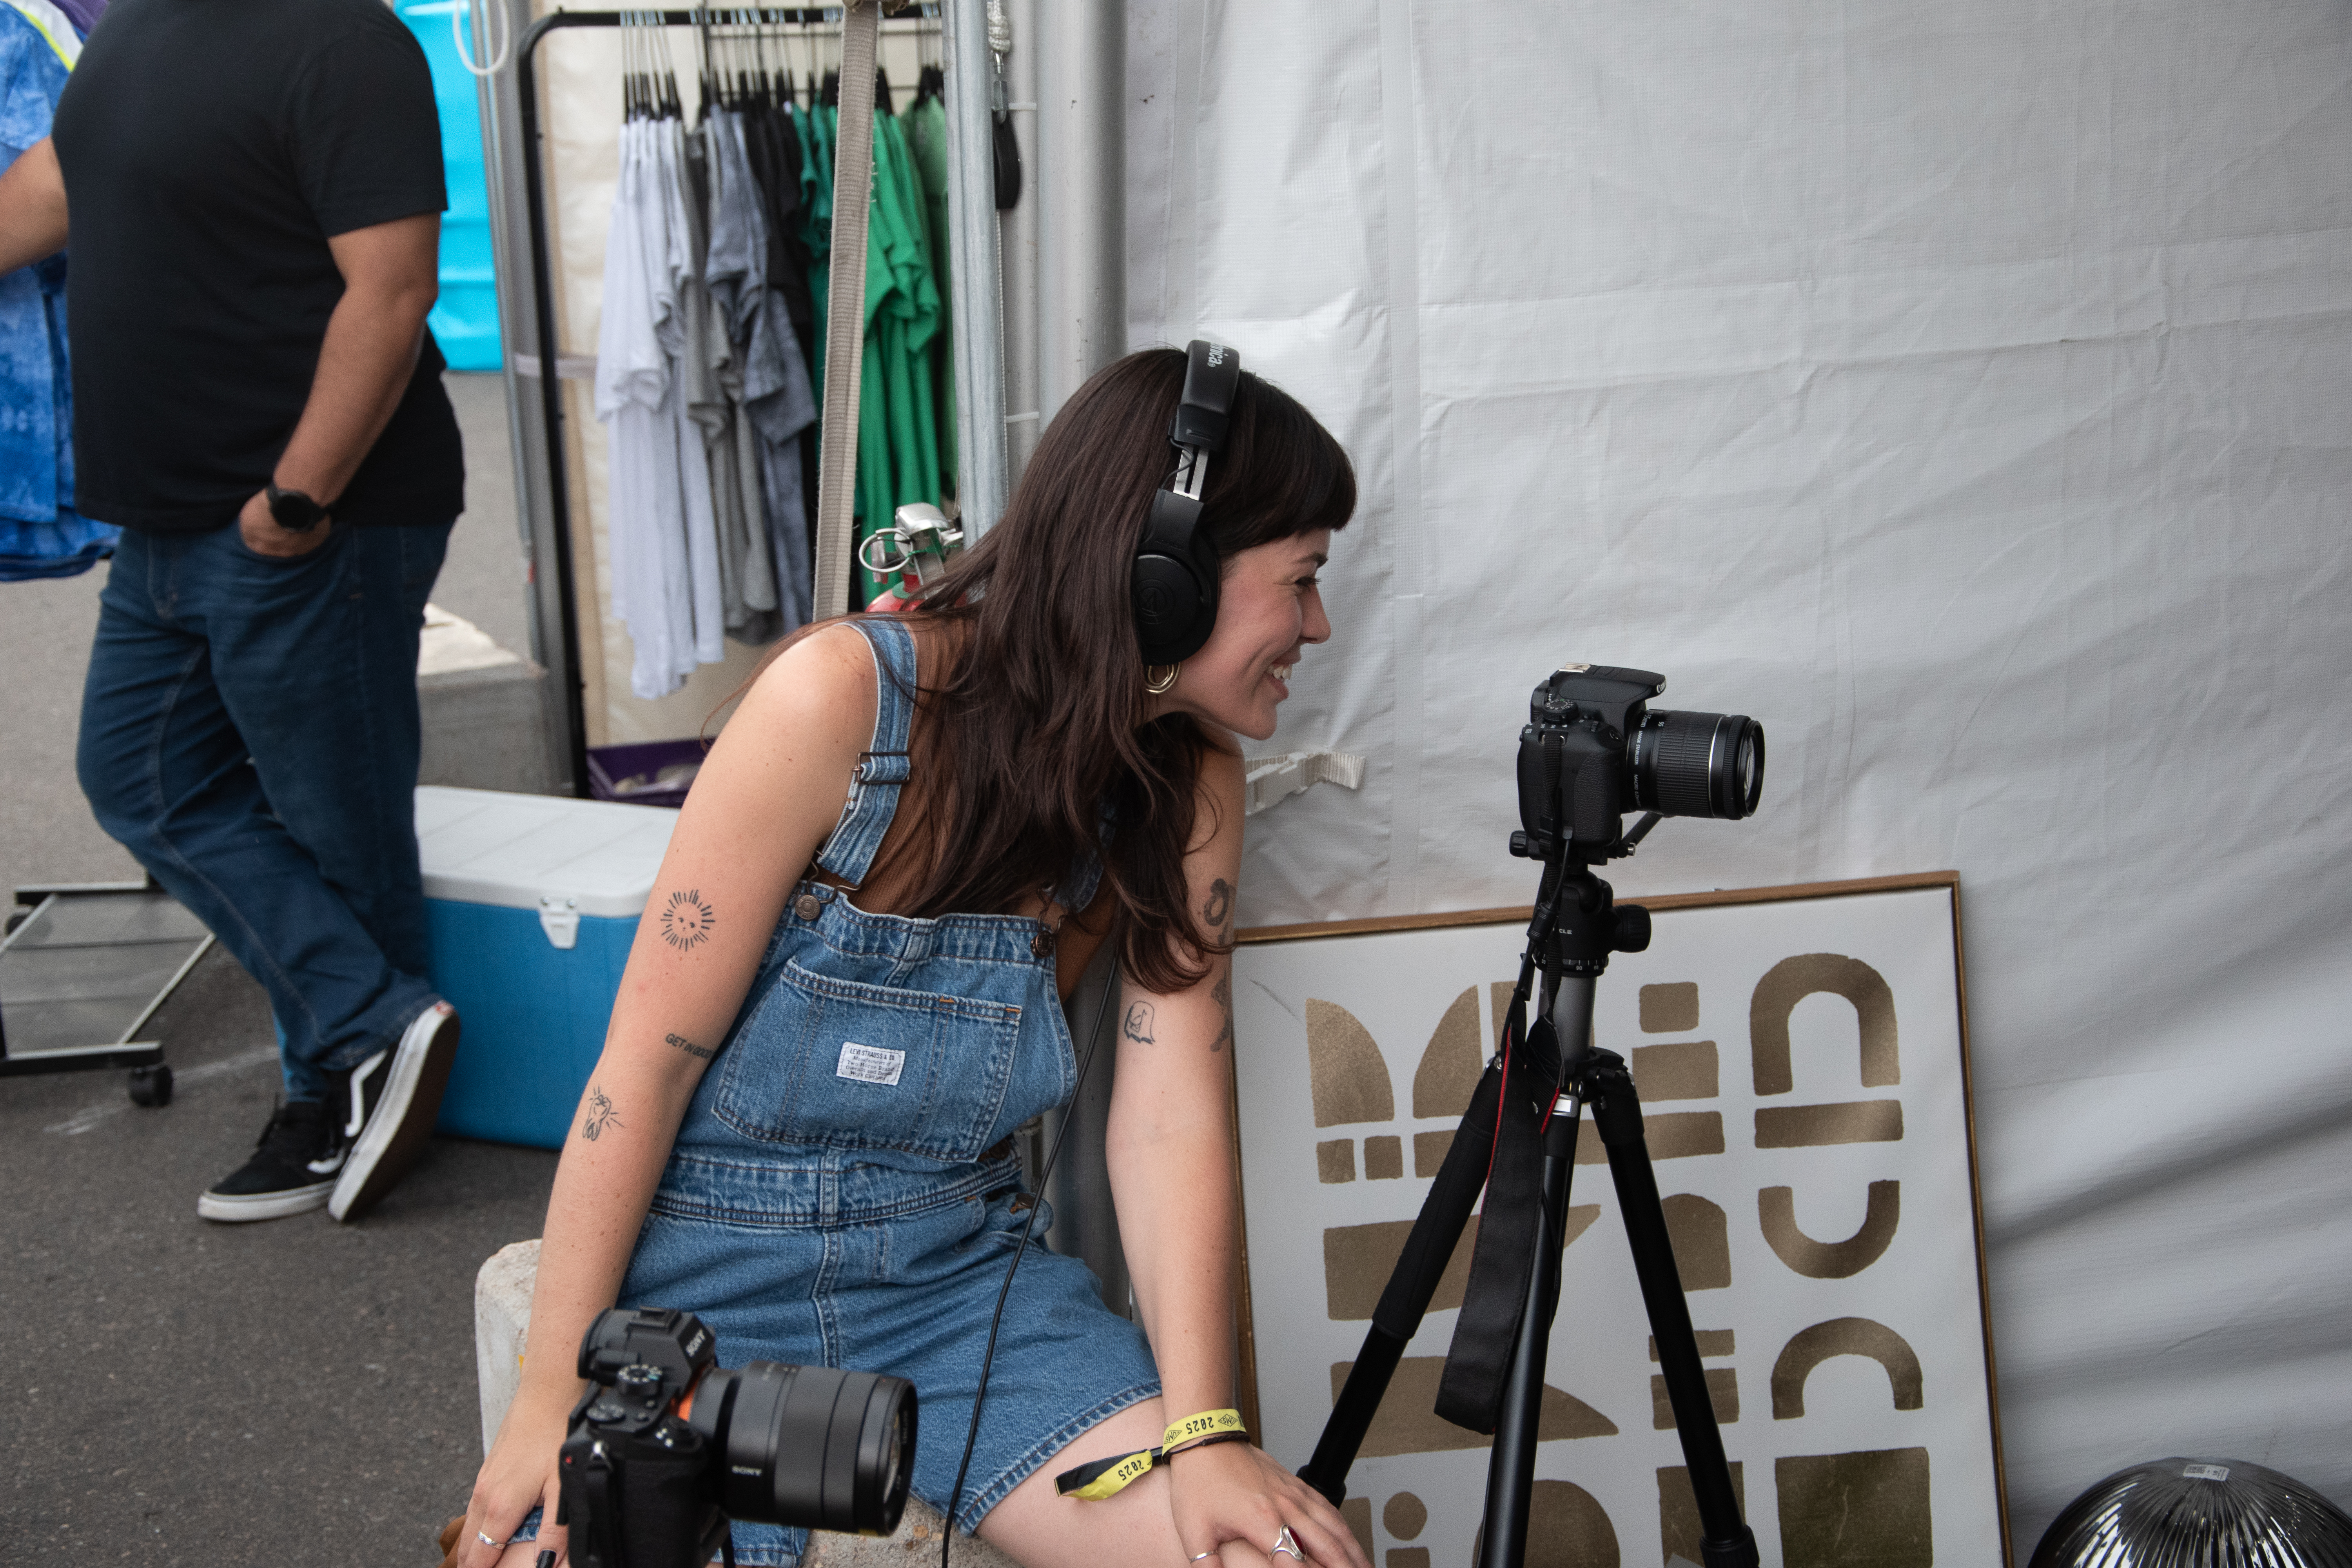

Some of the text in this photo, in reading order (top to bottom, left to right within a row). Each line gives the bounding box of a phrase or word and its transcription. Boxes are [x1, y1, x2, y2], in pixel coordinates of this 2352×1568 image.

[665, 1033, 687, 1048] GET
[684, 1043, 695, 1053] IN
[862, 1051, 882, 1059] STRAUSS
[686, 1328, 705, 1357] SONY
[1186, 1417, 1214, 1434] 2025
[732, 1465, 762, 1477] SONY
[1118, 1460, 1144, 1481] 2025
